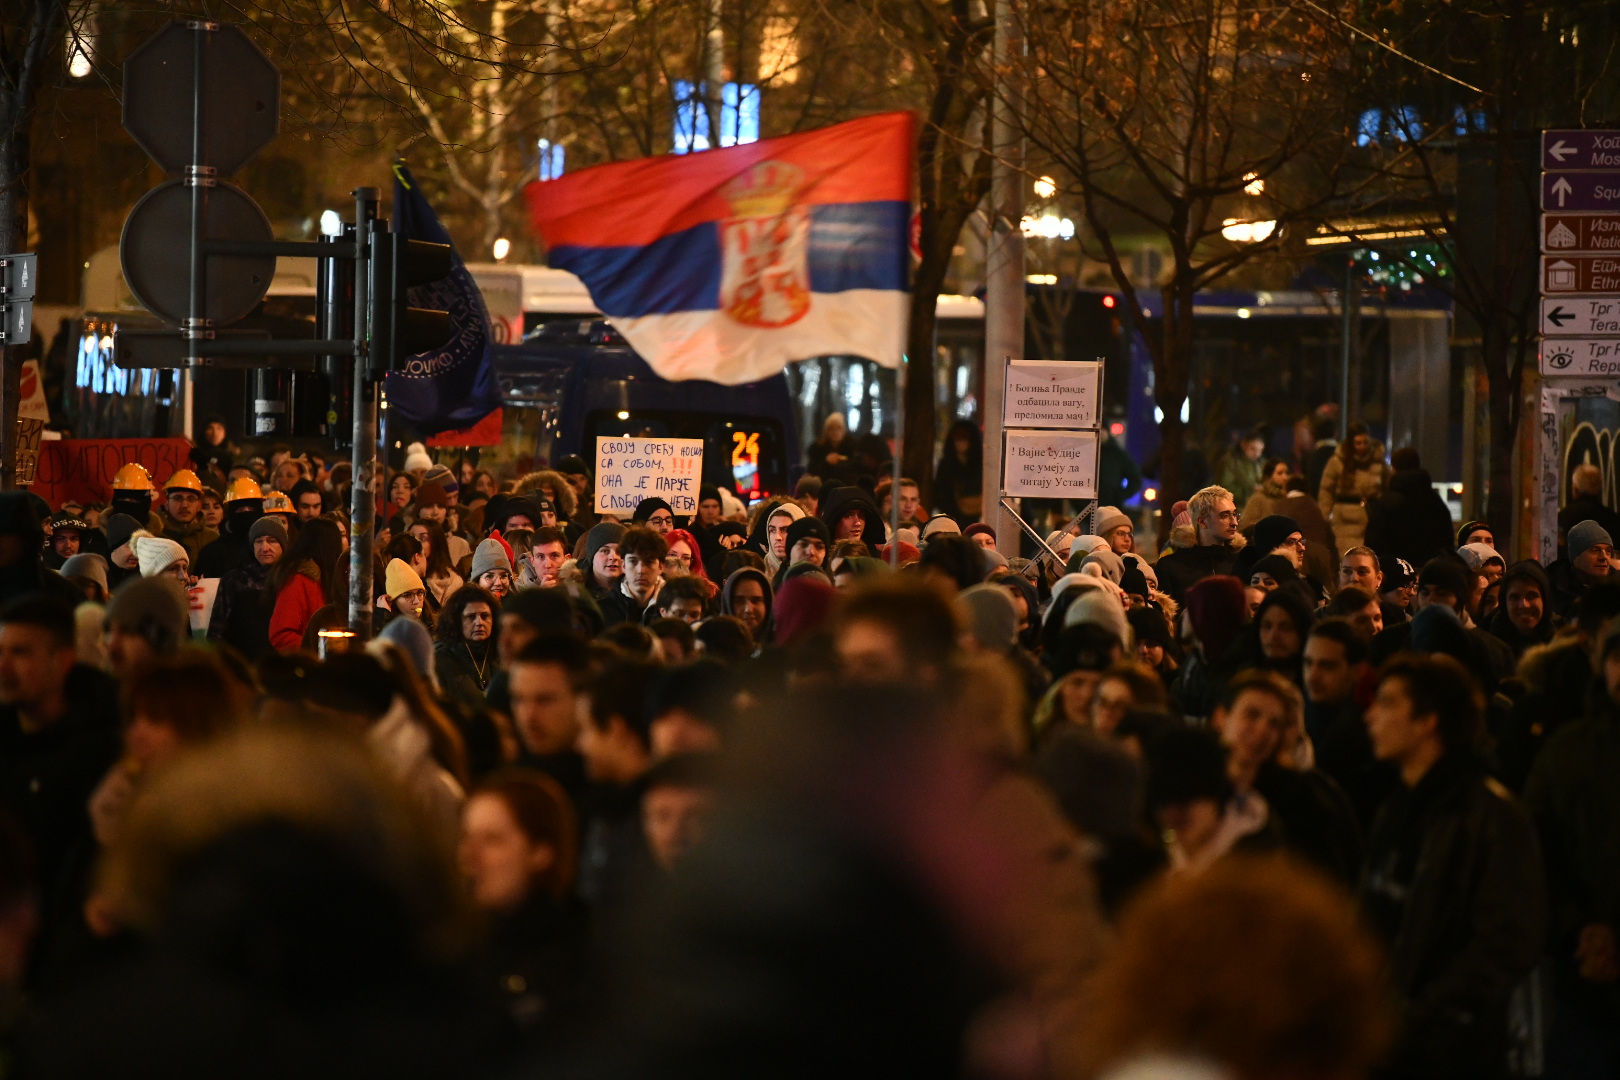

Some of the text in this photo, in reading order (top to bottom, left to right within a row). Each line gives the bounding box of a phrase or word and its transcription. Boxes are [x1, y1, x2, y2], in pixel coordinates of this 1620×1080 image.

[1594, 185, 1620, 201] Squ
[1590, 319, 1620, 331] Tera
[1015, 384, 1050, 393] Богиња
[1052, 384, 1086, 395] Правде
[1017, 397, 1085, 408] одбацила вагу,
[1014, 412, 1064, 421] преломила
[1066, 413, 1083, 421] мач
[601, 442, 635, 455] СВОЈУ
[644, 443, 674, 456] СРЕЋУ
[1018, 447, 1046, 458] Вајне
[1048, 448, 1081, 459] судије
[601, 458, 613, 469] СА
[623, 459, 665, 473] СОБОМ,
[1037, 462, 1066, 474] умеју
[1067, 465, 1080, 473] да
[601, 474, 622, 488] ОНА
[634, 475, 650, 489] ЈЕ
[1020, 476, 1052, 488] читају
[1055, 477, 1084, 487] Устав
[670, 495, 696, 511] НЕБА
